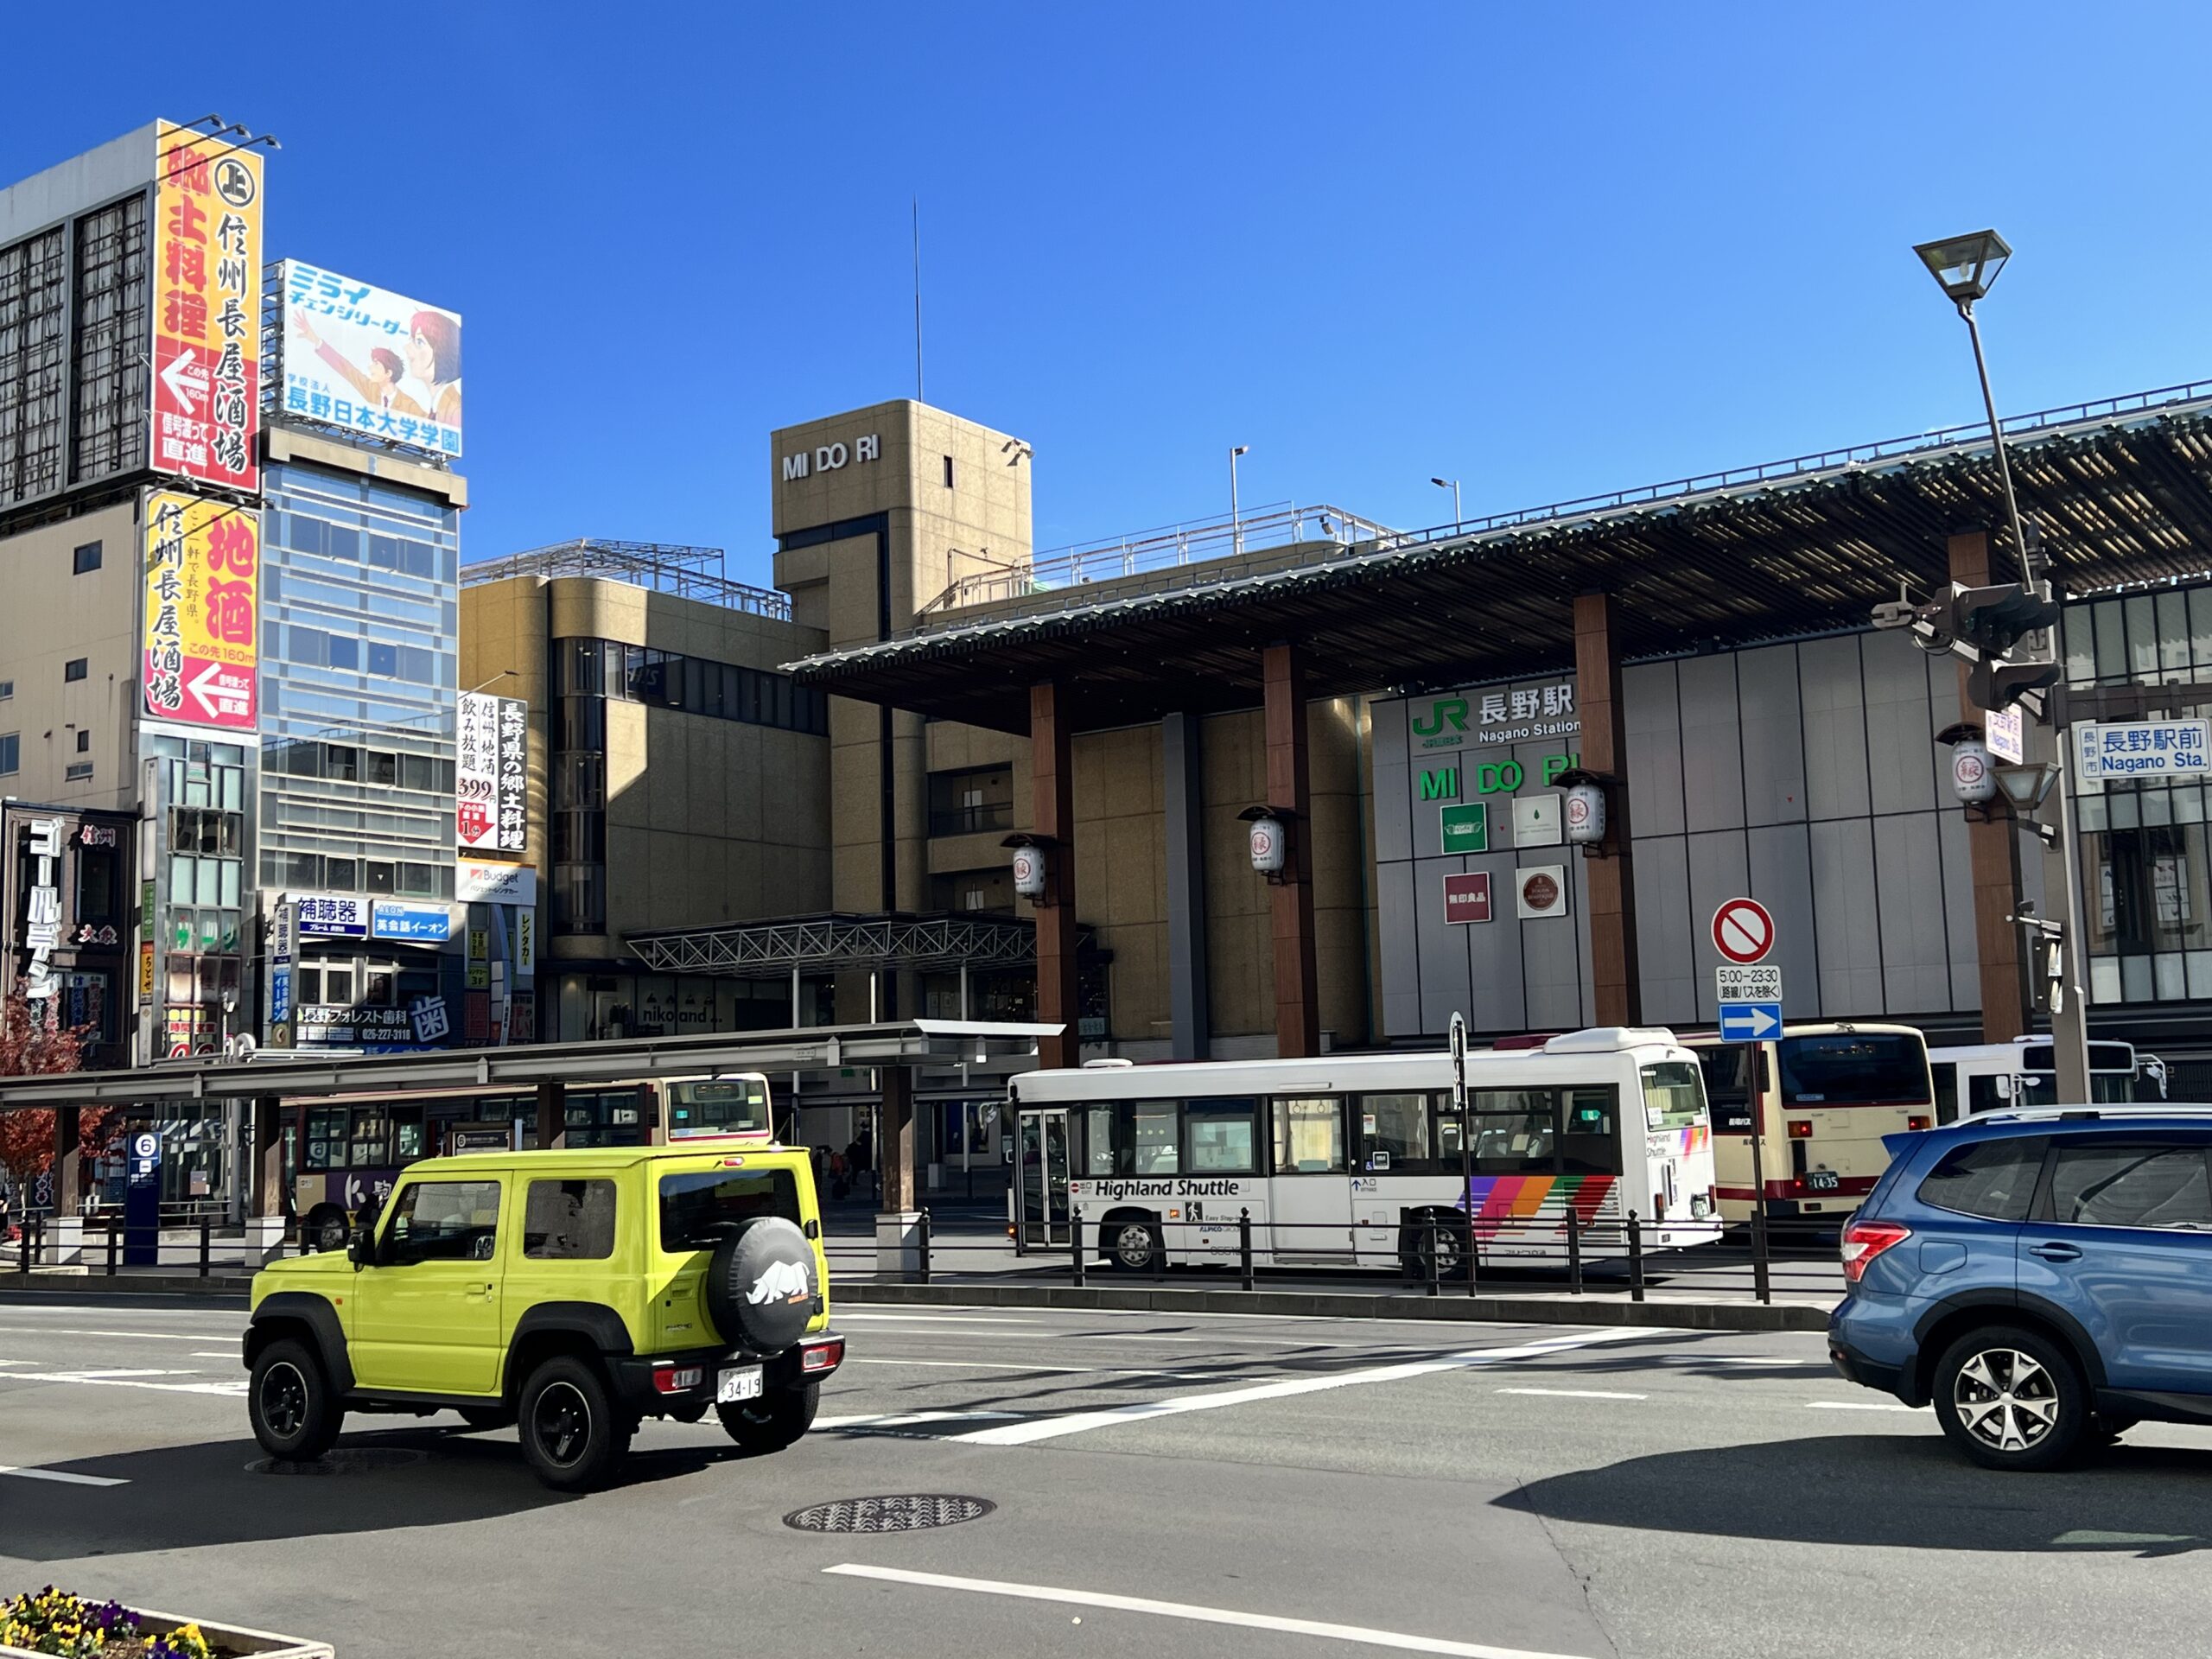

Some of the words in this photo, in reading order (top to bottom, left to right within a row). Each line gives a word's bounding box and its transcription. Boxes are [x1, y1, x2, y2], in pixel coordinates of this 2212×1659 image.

[164, 143, 210, 340] 郷土料理
[289, 265, 371, 305] ミライ
[289, 290, 409, 335] チェンジリーダー
[213, 213, 248, 472] 信州長屋酒場
[187, 365, 209, 380] この先
[186, 388, 209, 402] 160m
[287, 386, 459, 454] 長野日本大学学園
[162, 436, 207, 467] 直進
[783, 453, 810, 481] MI
[816, 442, 849, 472] DO
[856, 434, 880, 462] RI
[206, 514, 254, 646] 地酒
[149, 502, 182, 709] 信州長屋酒場
[189, 643, 220, 659] この先
[223, 648, 254, 664] 160m
[219, 698, 248, 716] 直進
[1413, 697, 1469, 736] JR
[1479, 683, 1574, 725] 長野駅
[461, 697, 477, 772] 飲み放題
[480, 701, 495, 777] 信州地酒
[1479, 726, 1529, 744] Nagano
[1534, 721, 1580, 737] Station
[2083, 731, 2098, 772] 長野市
[2103, 727, 2202, 753] 長野駅前
[499, 702, 525, 849] 長野県の郷土料理
[1420, 767, 1457, 800] MI
[1478, 760, 1522, 794] DO
[2101, 755, 2165, 772] Nagano
[2174, 753, 2208, 767] Sta.
[81, 824, 116, 847] 信州
[484, 869, 518, 885] Budget
[27, 816, 65, 999] ゴールデン
[299, 896, 357, 923] 補聴器
[377, 918, 448, 934] 英会話イーオン
[378, 905, 404, 915] AEON
[521, 913, 531, 966] レンタカー
[303, 1008, 407, 1024] 長野フォレスト歯科
[410, 995, 449, 1043] 歯
[643, 1006, 674, 1022] niko
[679, 1007, 707, 1023] and
[141, 1139, 151, 1153] 6
[1096, 1179, 1172, 1200] Highland
[1177, 1179, 1239, 1196] Shuttle
